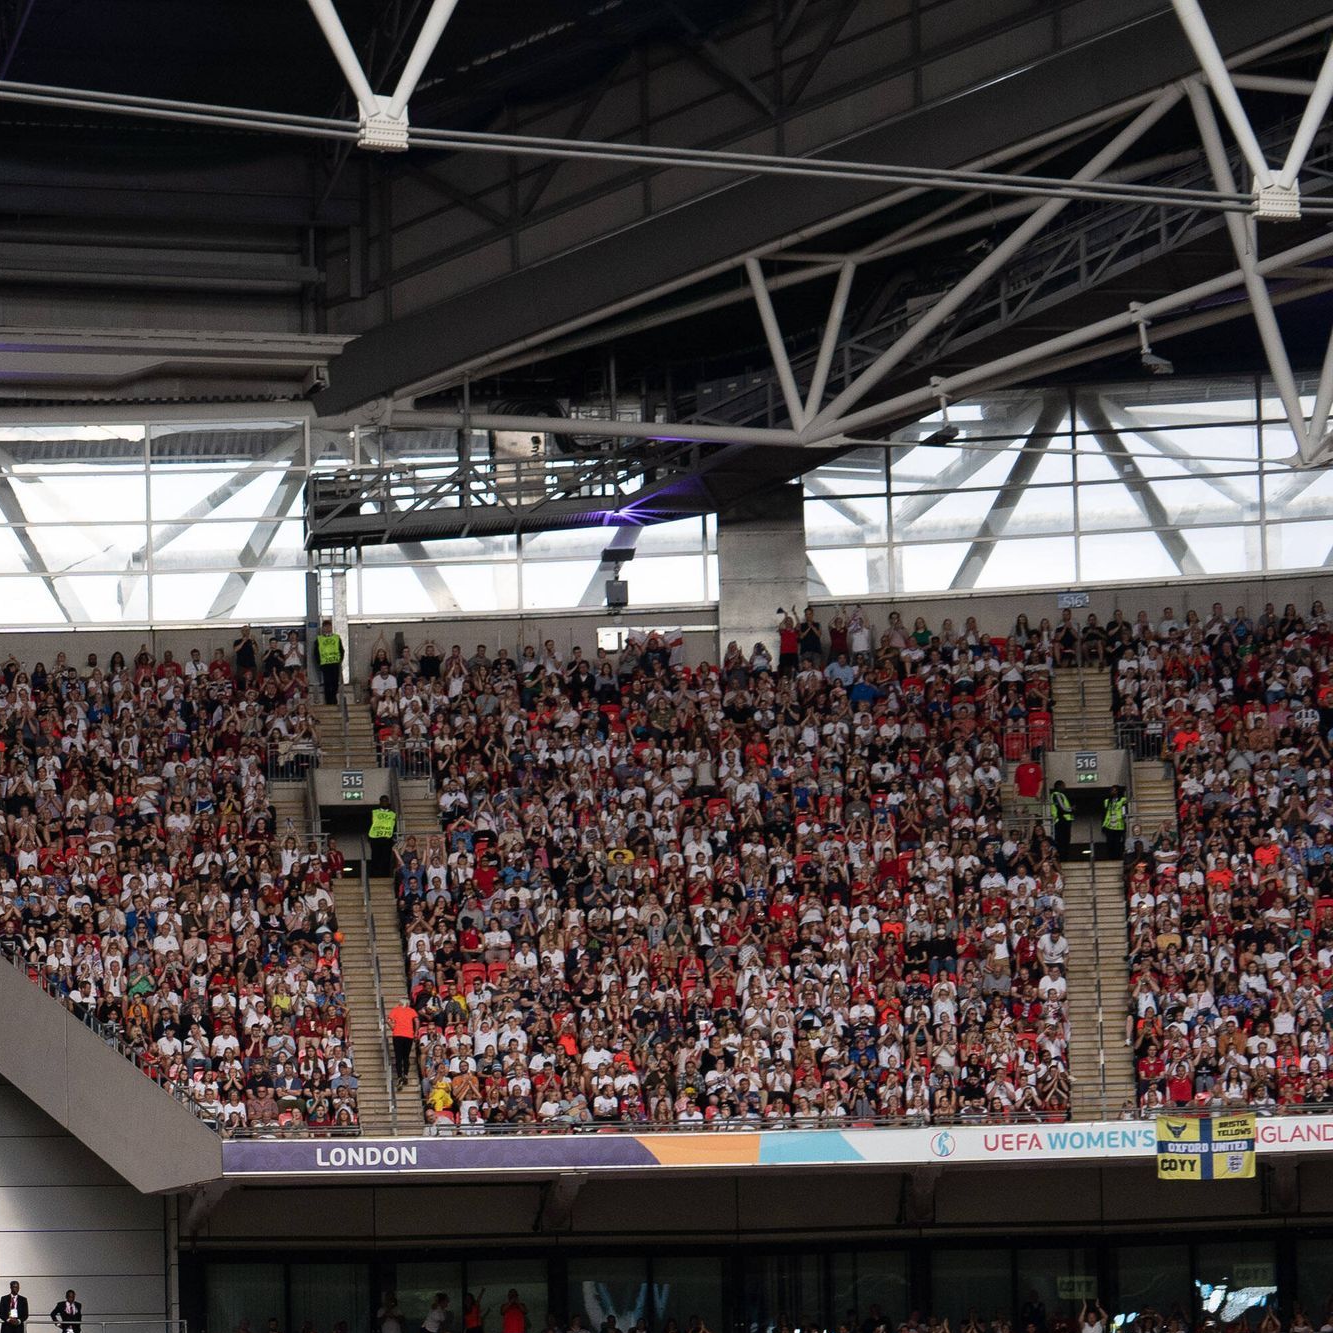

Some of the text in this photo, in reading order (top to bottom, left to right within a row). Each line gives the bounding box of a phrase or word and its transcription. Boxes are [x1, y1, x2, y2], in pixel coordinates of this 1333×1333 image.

[1076, 758, 1096, 768] 516
[343, 776, 362, 786] 515
[1219, 1120, 1250, 1128] BRISTOL
[984, 1123, 1333, 1151] UEFA WOMEN'S GLAND
[1217, 1128, 1251, 1137] YELLOWS
[1168, 1140, 1248, 1153] OXFORD UNITED
[316, 1146, 417, 1167] LONDON
[1161, 1158, 1197, 1172] COYY
